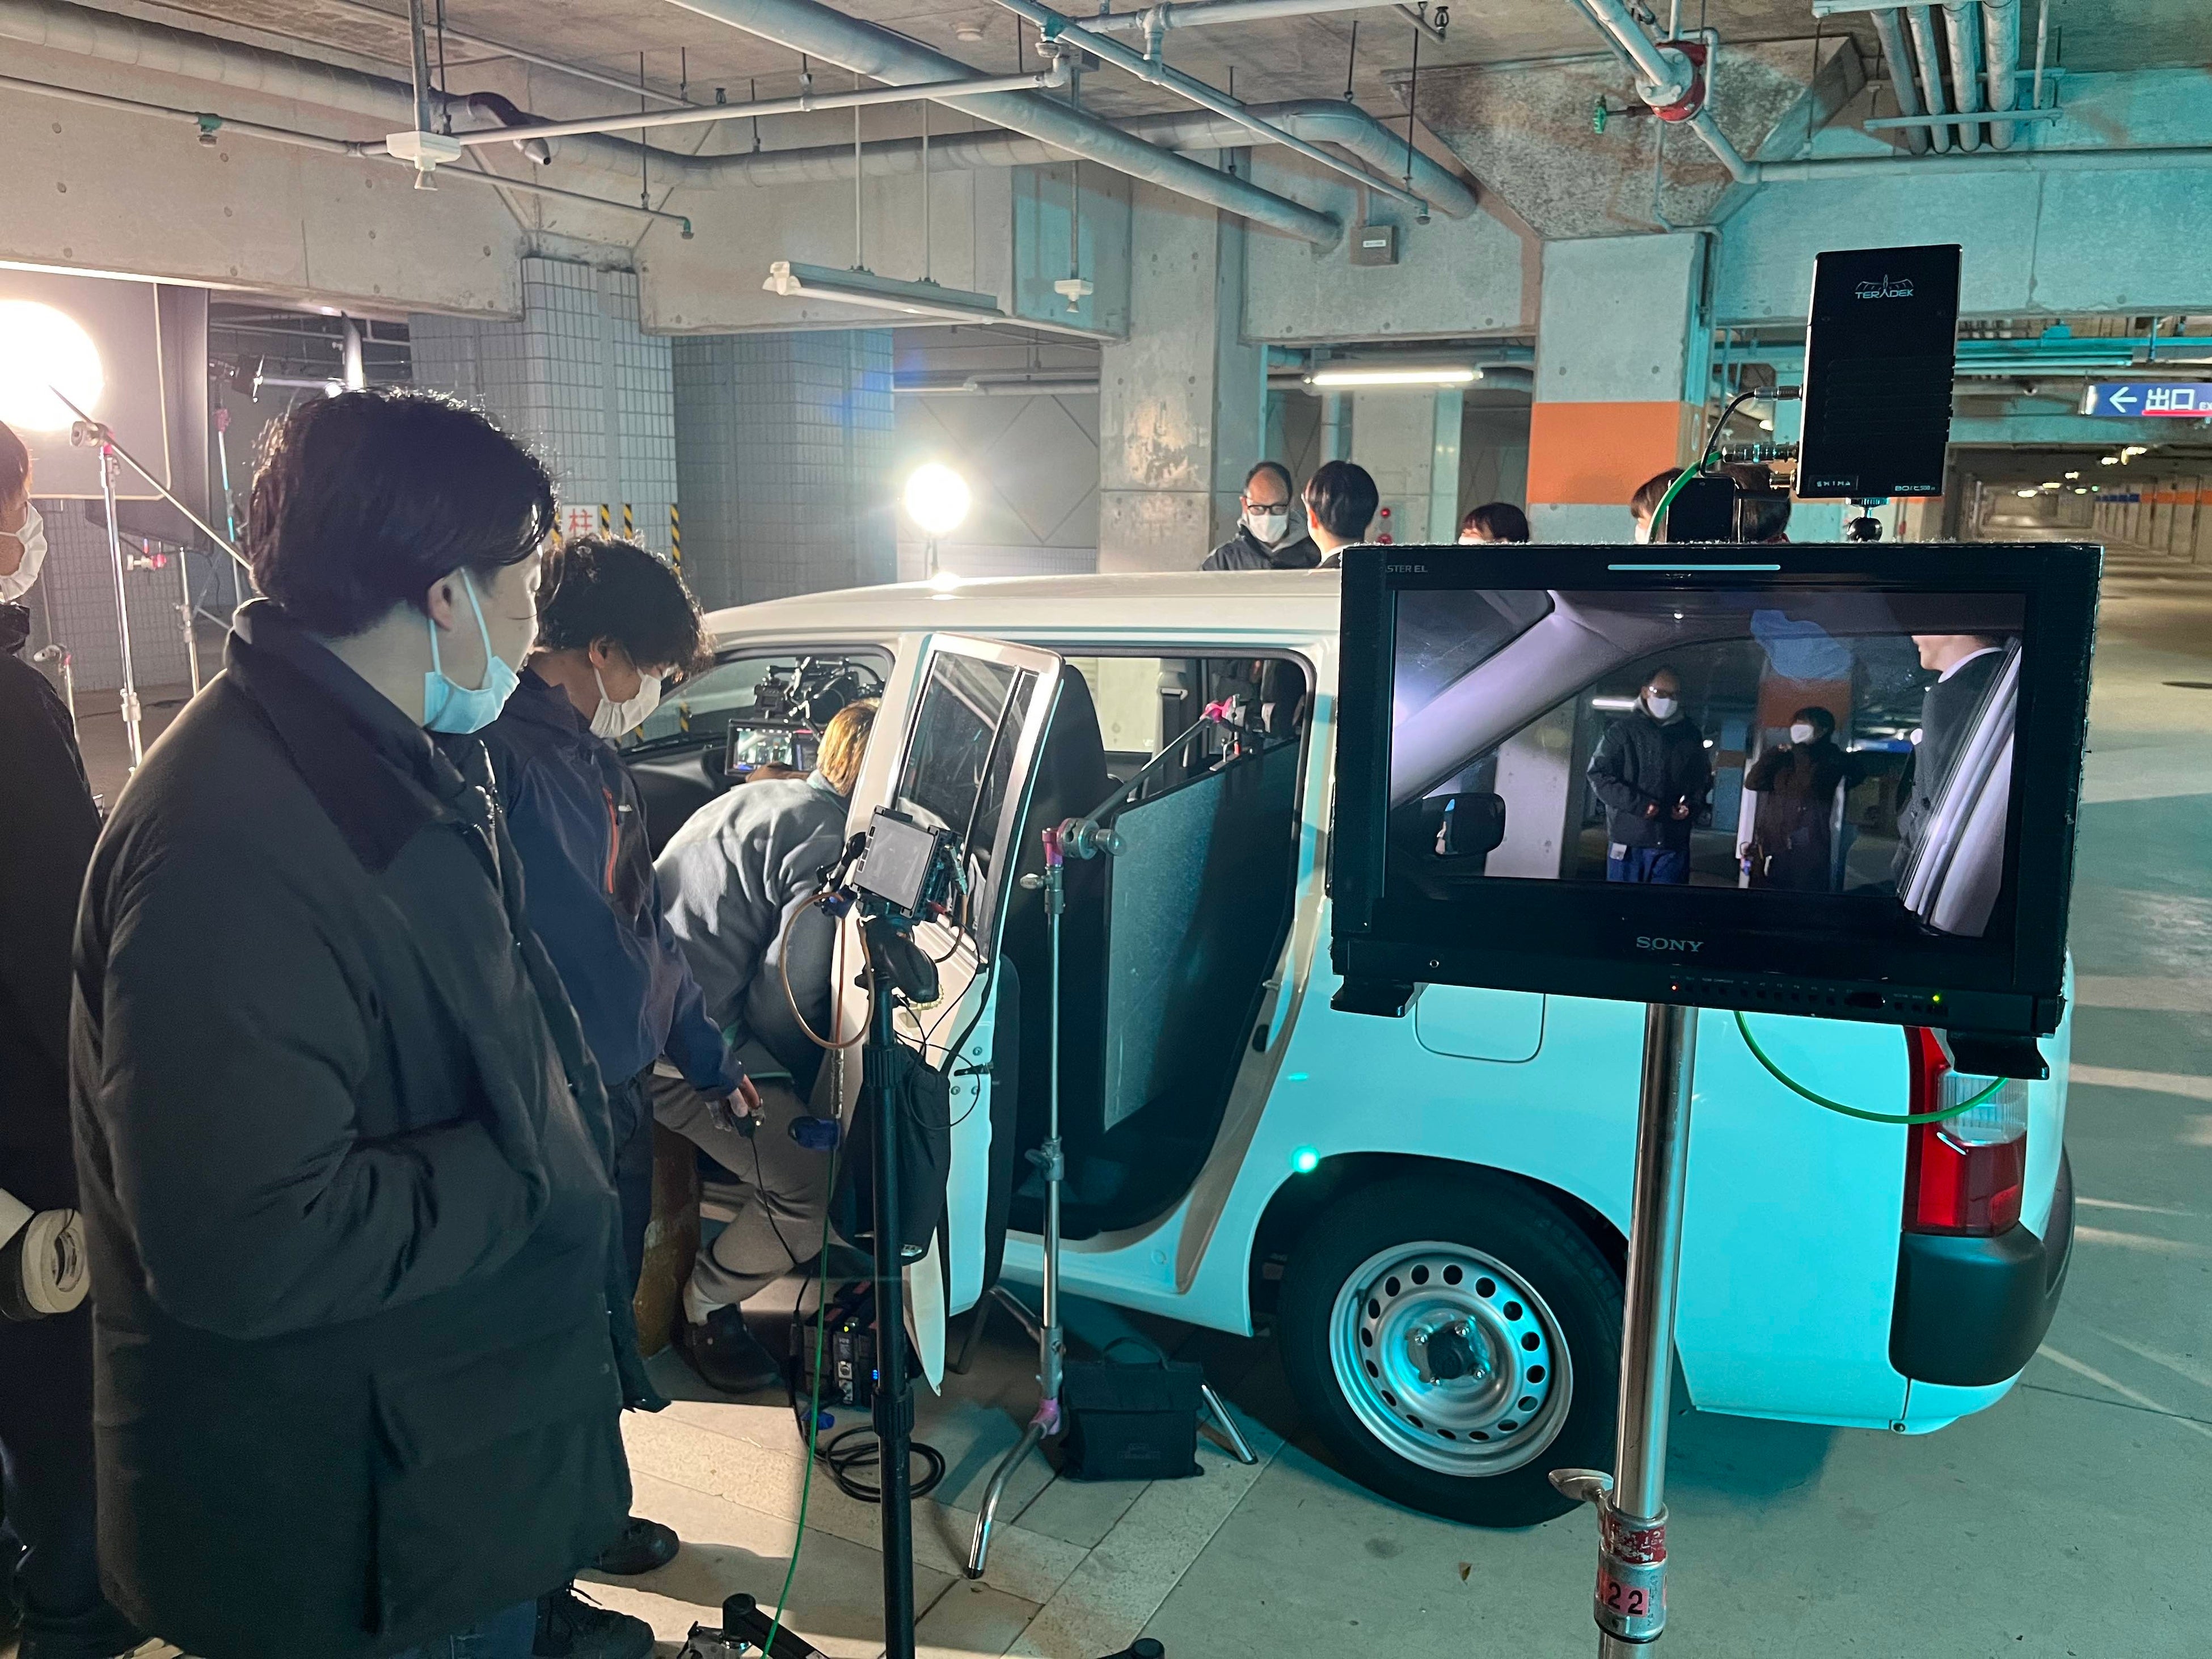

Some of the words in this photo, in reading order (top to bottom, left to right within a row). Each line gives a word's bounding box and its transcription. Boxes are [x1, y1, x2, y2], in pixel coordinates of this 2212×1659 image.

[1855, 289, 1914, 299] TERADEK
[2145, 387, 2194, 410] 出口
[569, 508, 593, 537] 柱
[1636, 936, 1704, 952] SONY
